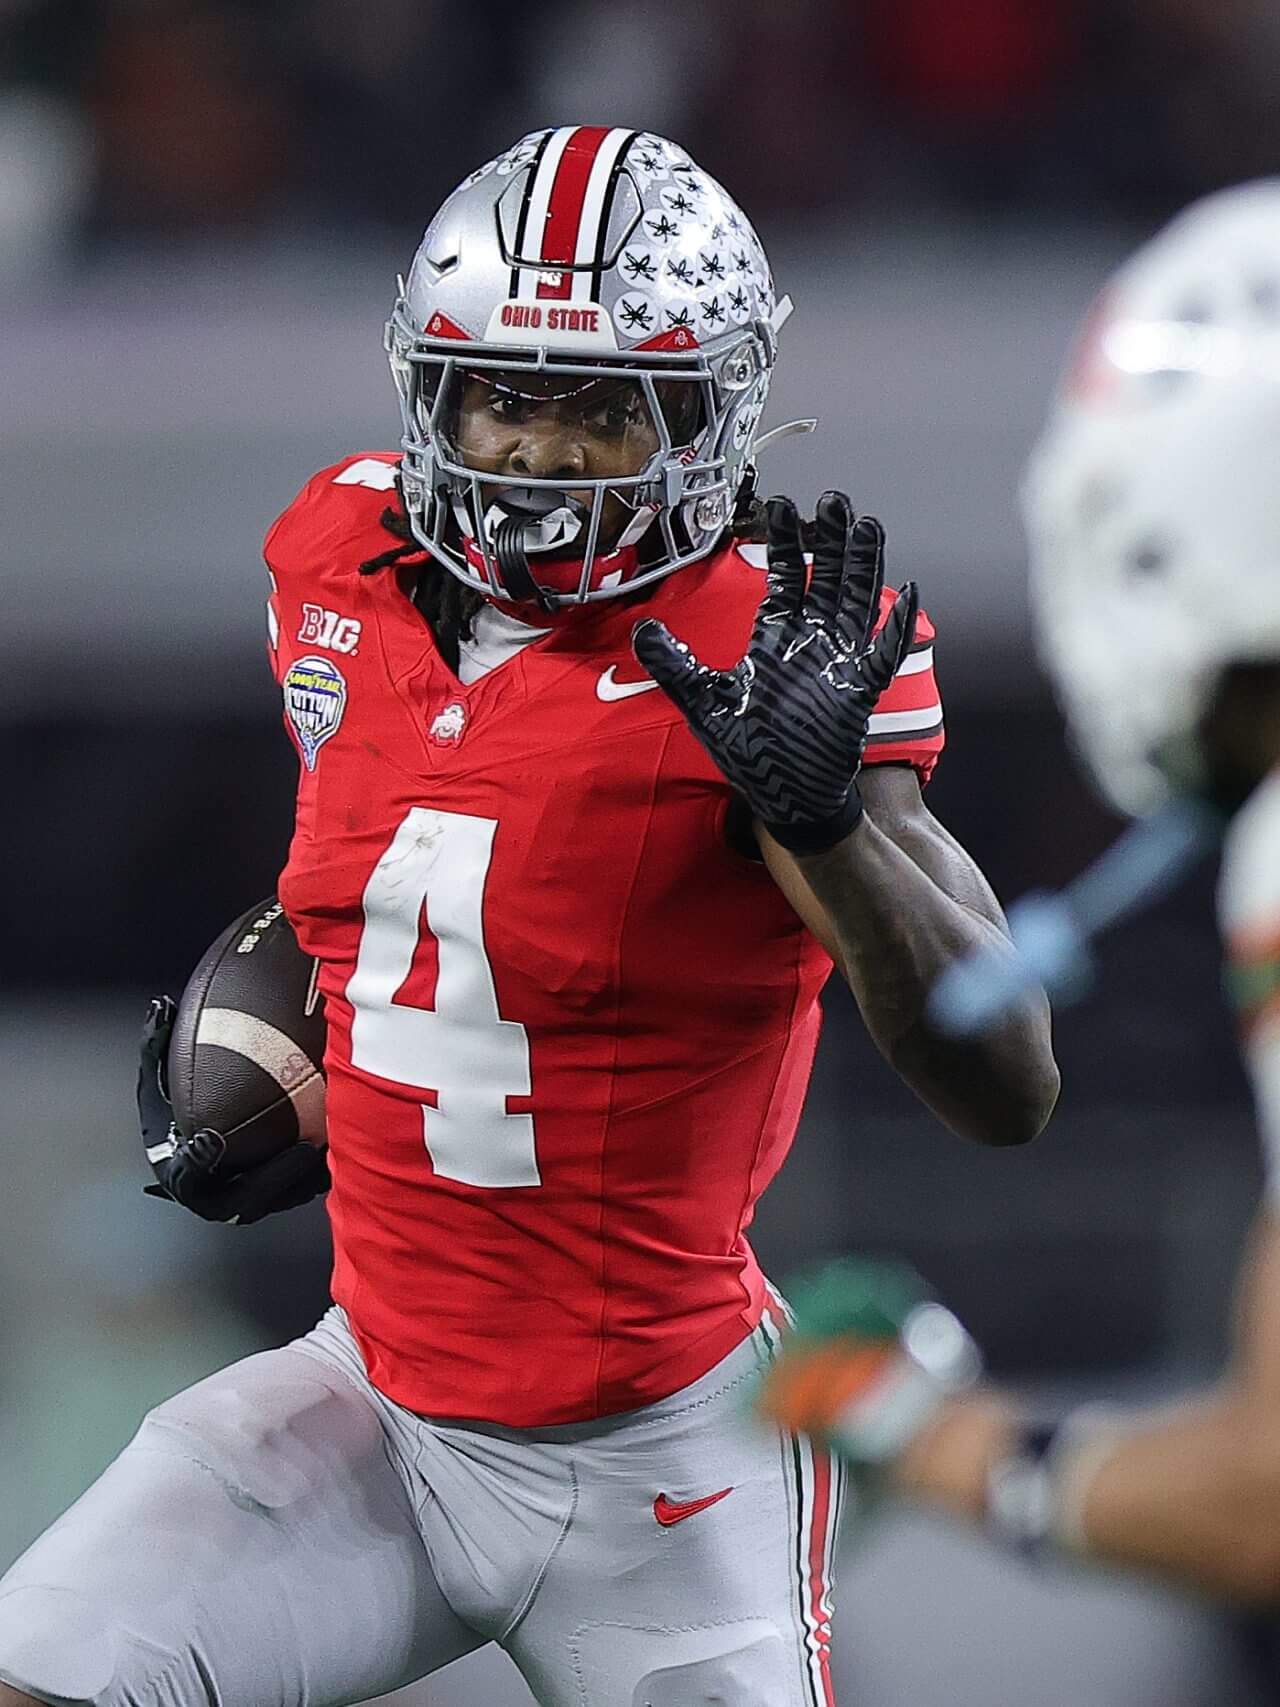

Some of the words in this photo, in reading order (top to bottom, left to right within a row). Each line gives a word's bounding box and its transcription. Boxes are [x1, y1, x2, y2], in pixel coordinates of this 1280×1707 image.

[501, 305, 541, 328] OHIO
[546, 308, 599, 332] STATE
[346, 806, 542, 1188] 4
